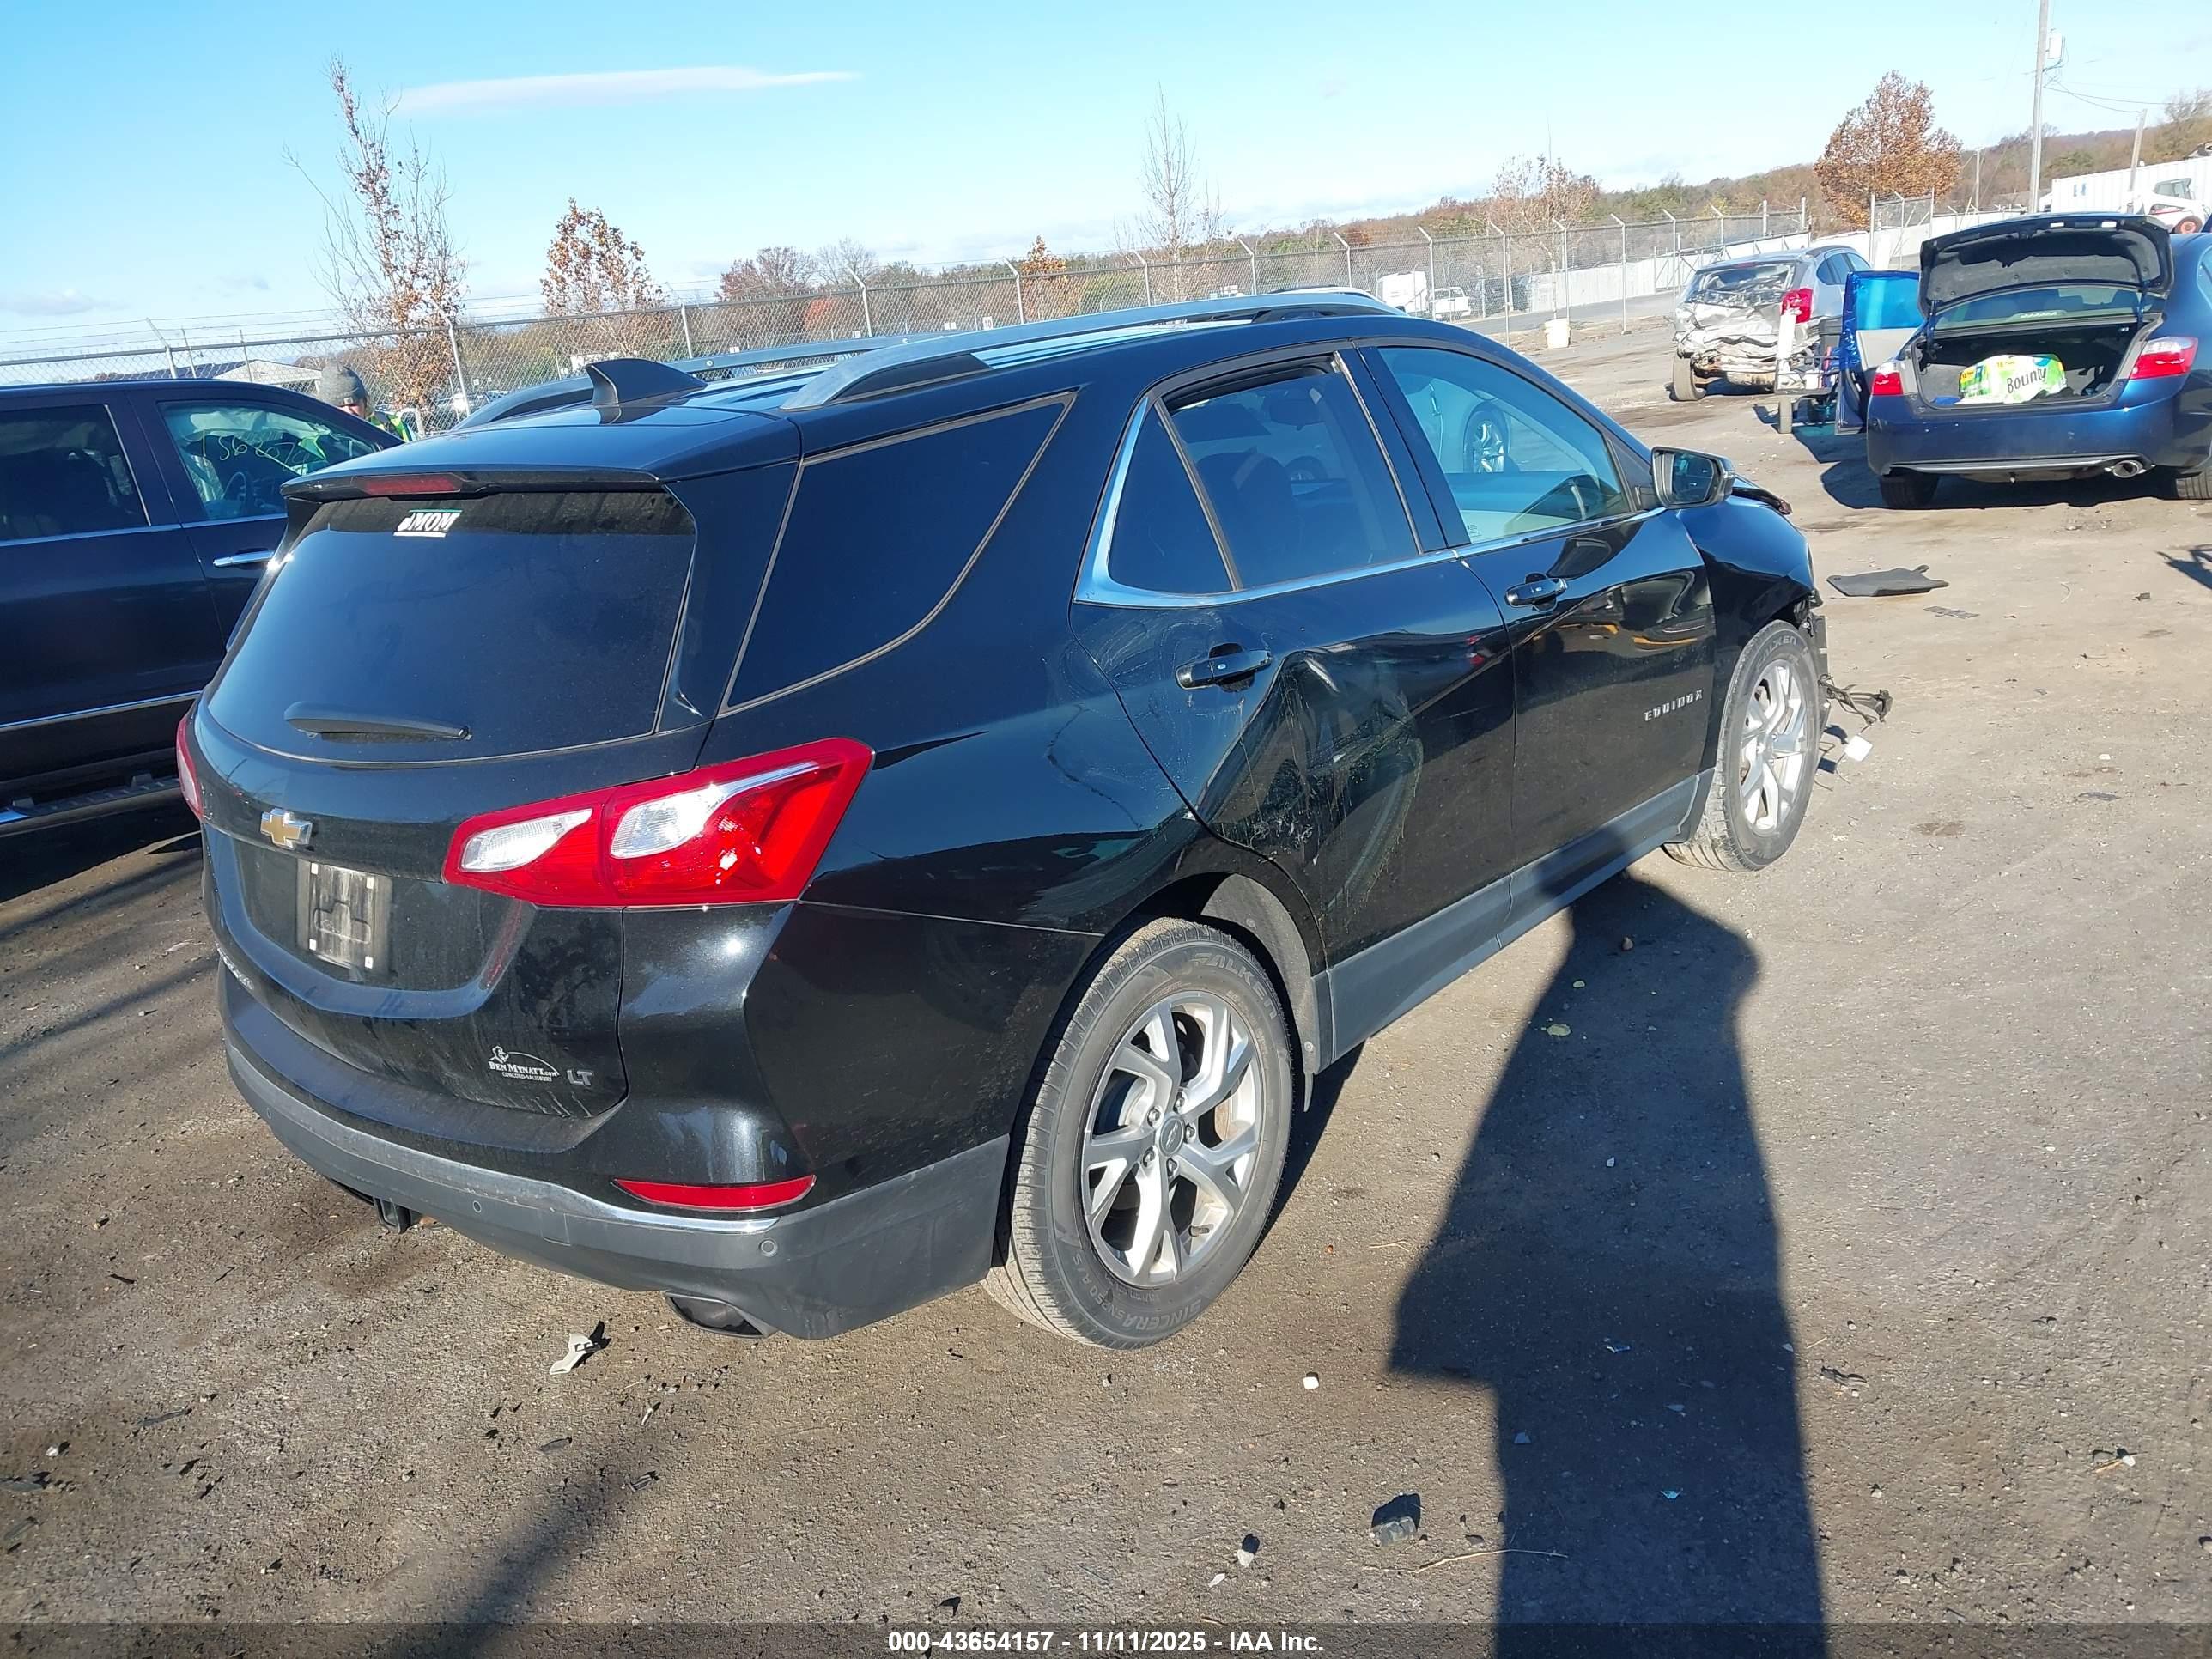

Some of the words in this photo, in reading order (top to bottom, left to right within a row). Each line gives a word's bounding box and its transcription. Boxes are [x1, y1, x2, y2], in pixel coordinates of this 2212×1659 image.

[2006, 368, 2047, 393] Bounty
[1644, 689, 1704, 722] EQUINOX
[1191, 952, 1278, 1020] FALKEN
[488, 1060, 507, 1072] BEN
[566, 1069, 592, 1086] LT
[1073, 1252, 1092, 1284] A/S
[1122, 1298, 1202, 1330] SINCERA
